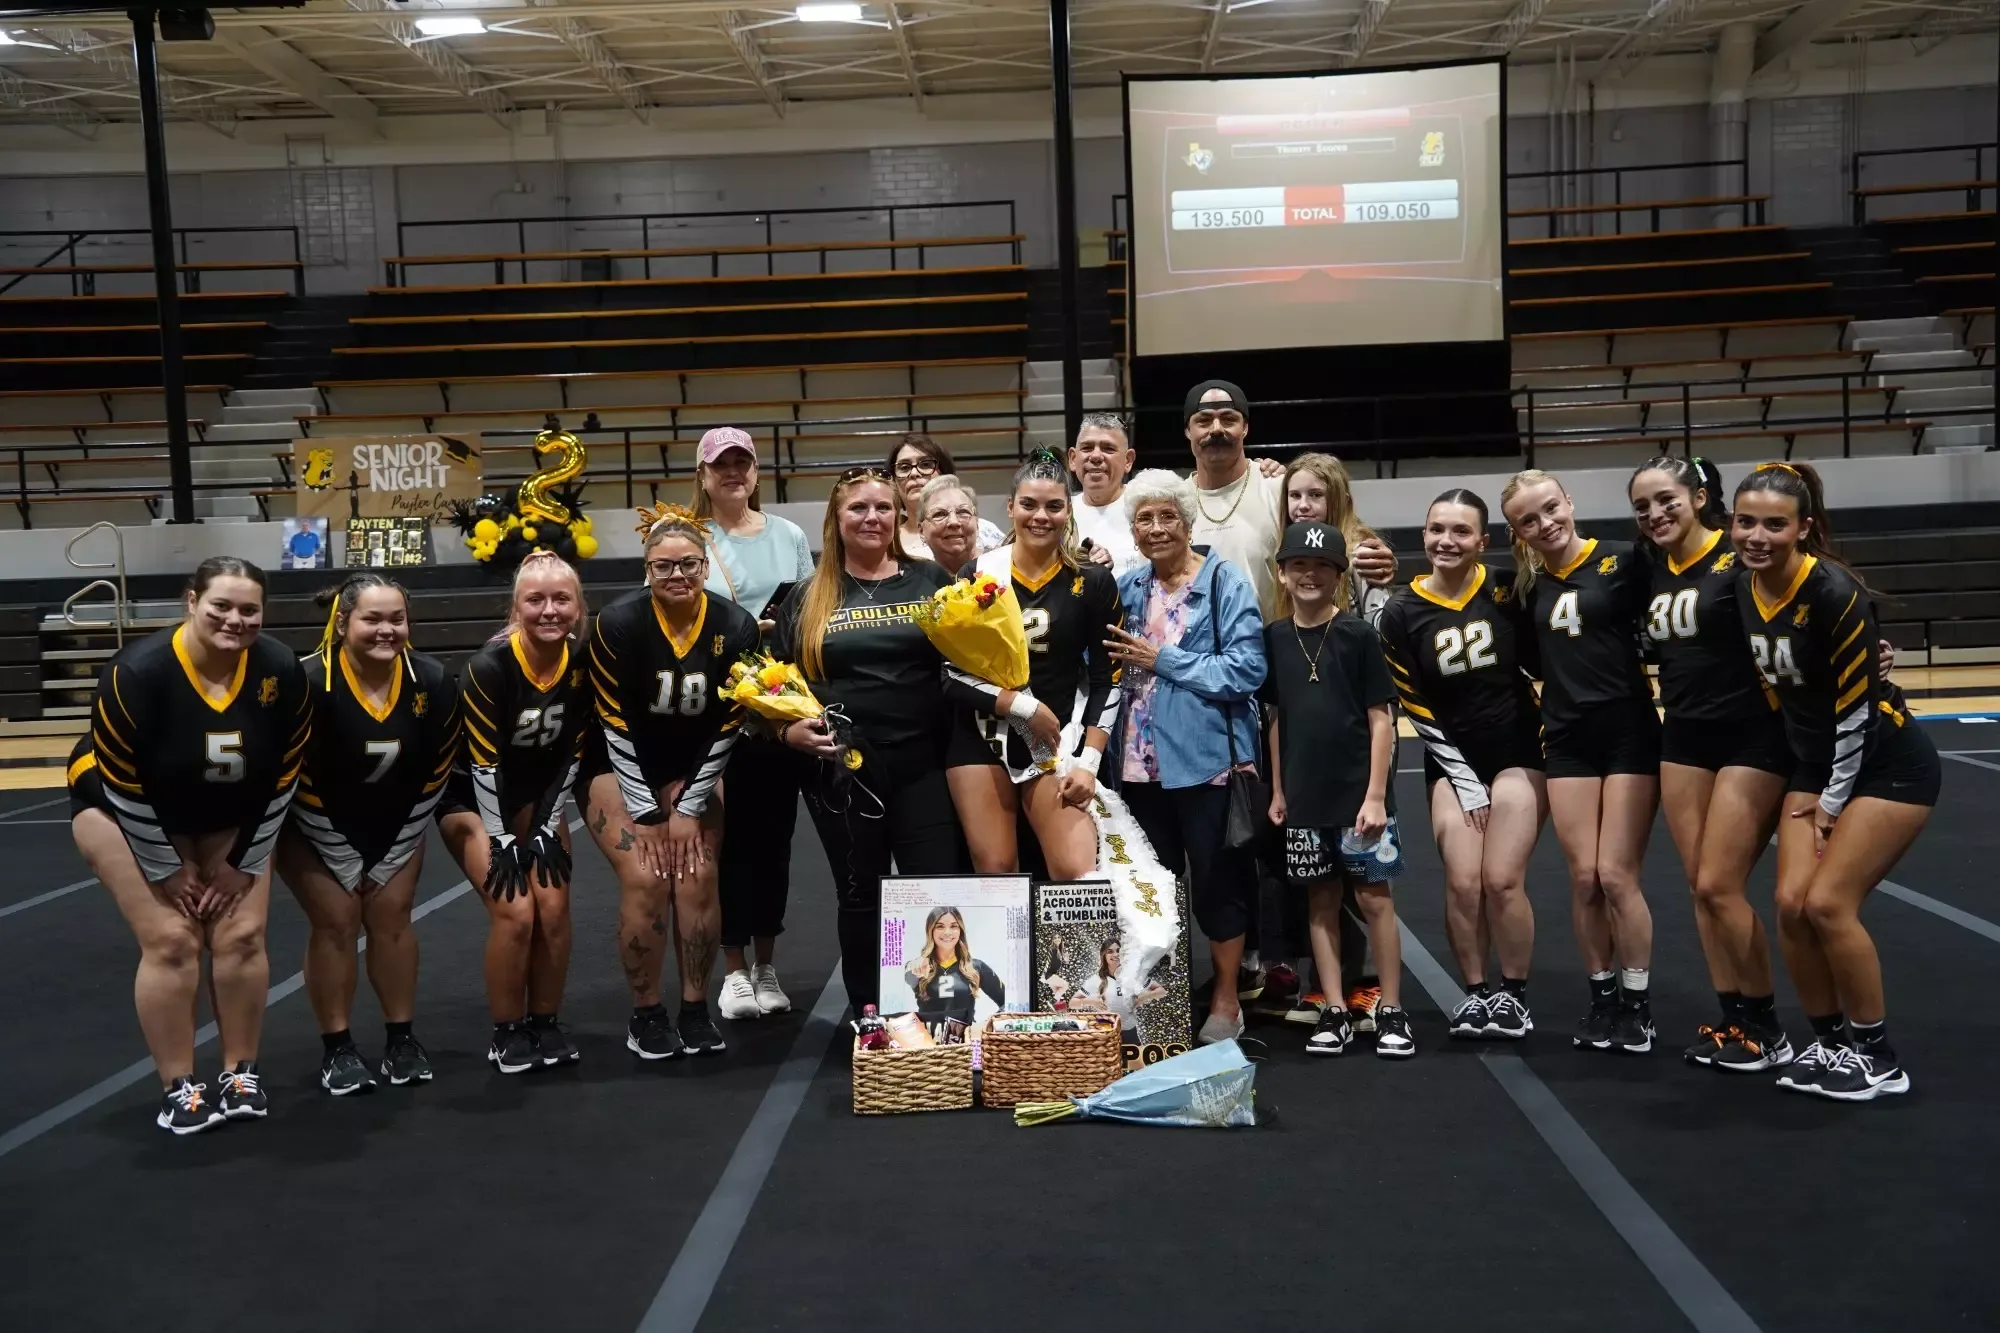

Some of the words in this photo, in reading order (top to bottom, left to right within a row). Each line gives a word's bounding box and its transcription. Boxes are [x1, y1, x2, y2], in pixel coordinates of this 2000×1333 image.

[1190, 209, 1264, 228] 139.500
[1292, 207, 1337, 221] TOTAL
[1355, 202, 1431, 221] 109.050
[352, 441, 443, 470] SENIOR
[370, 464, 451, 492] NIGHT
[391, 493, 430, 516] Payten
[350, 518, 395, 530] PAYTEN
[1304, 527, 1325, 548] NY
[404, 552, 422, 564] #2
[1550, 589, 1583, 637] 4
[1646, 587, 1700, 641] 30
[1021, 607, 1051, 653] 2
[1434, 618, 1498, 677] 22
[1750, 633, 1806, 687] 24
[649, 670, 708, 716] 18
[510, 702, 565, 750] 25
[204, 730, 247, 783] 5
[364, 739, 401, 784] 7
[1286, 827, 1305, 839] IT'S
[1286, 841, 1321, 852] MORE
[1286, 853, 1319, 865] THAN
[1286, 866, 1294, 877] A
[1296, 863, 1333, 878] GAME
[1042, 896, 1117, 909] ACROBATICS
[1043, 889, 1070, 897] TEXAS
[1043, 911, 1053, 921] &
[1056, 909, 1117, 921] TUMBLING
[938, 974, 955, 999] 2
